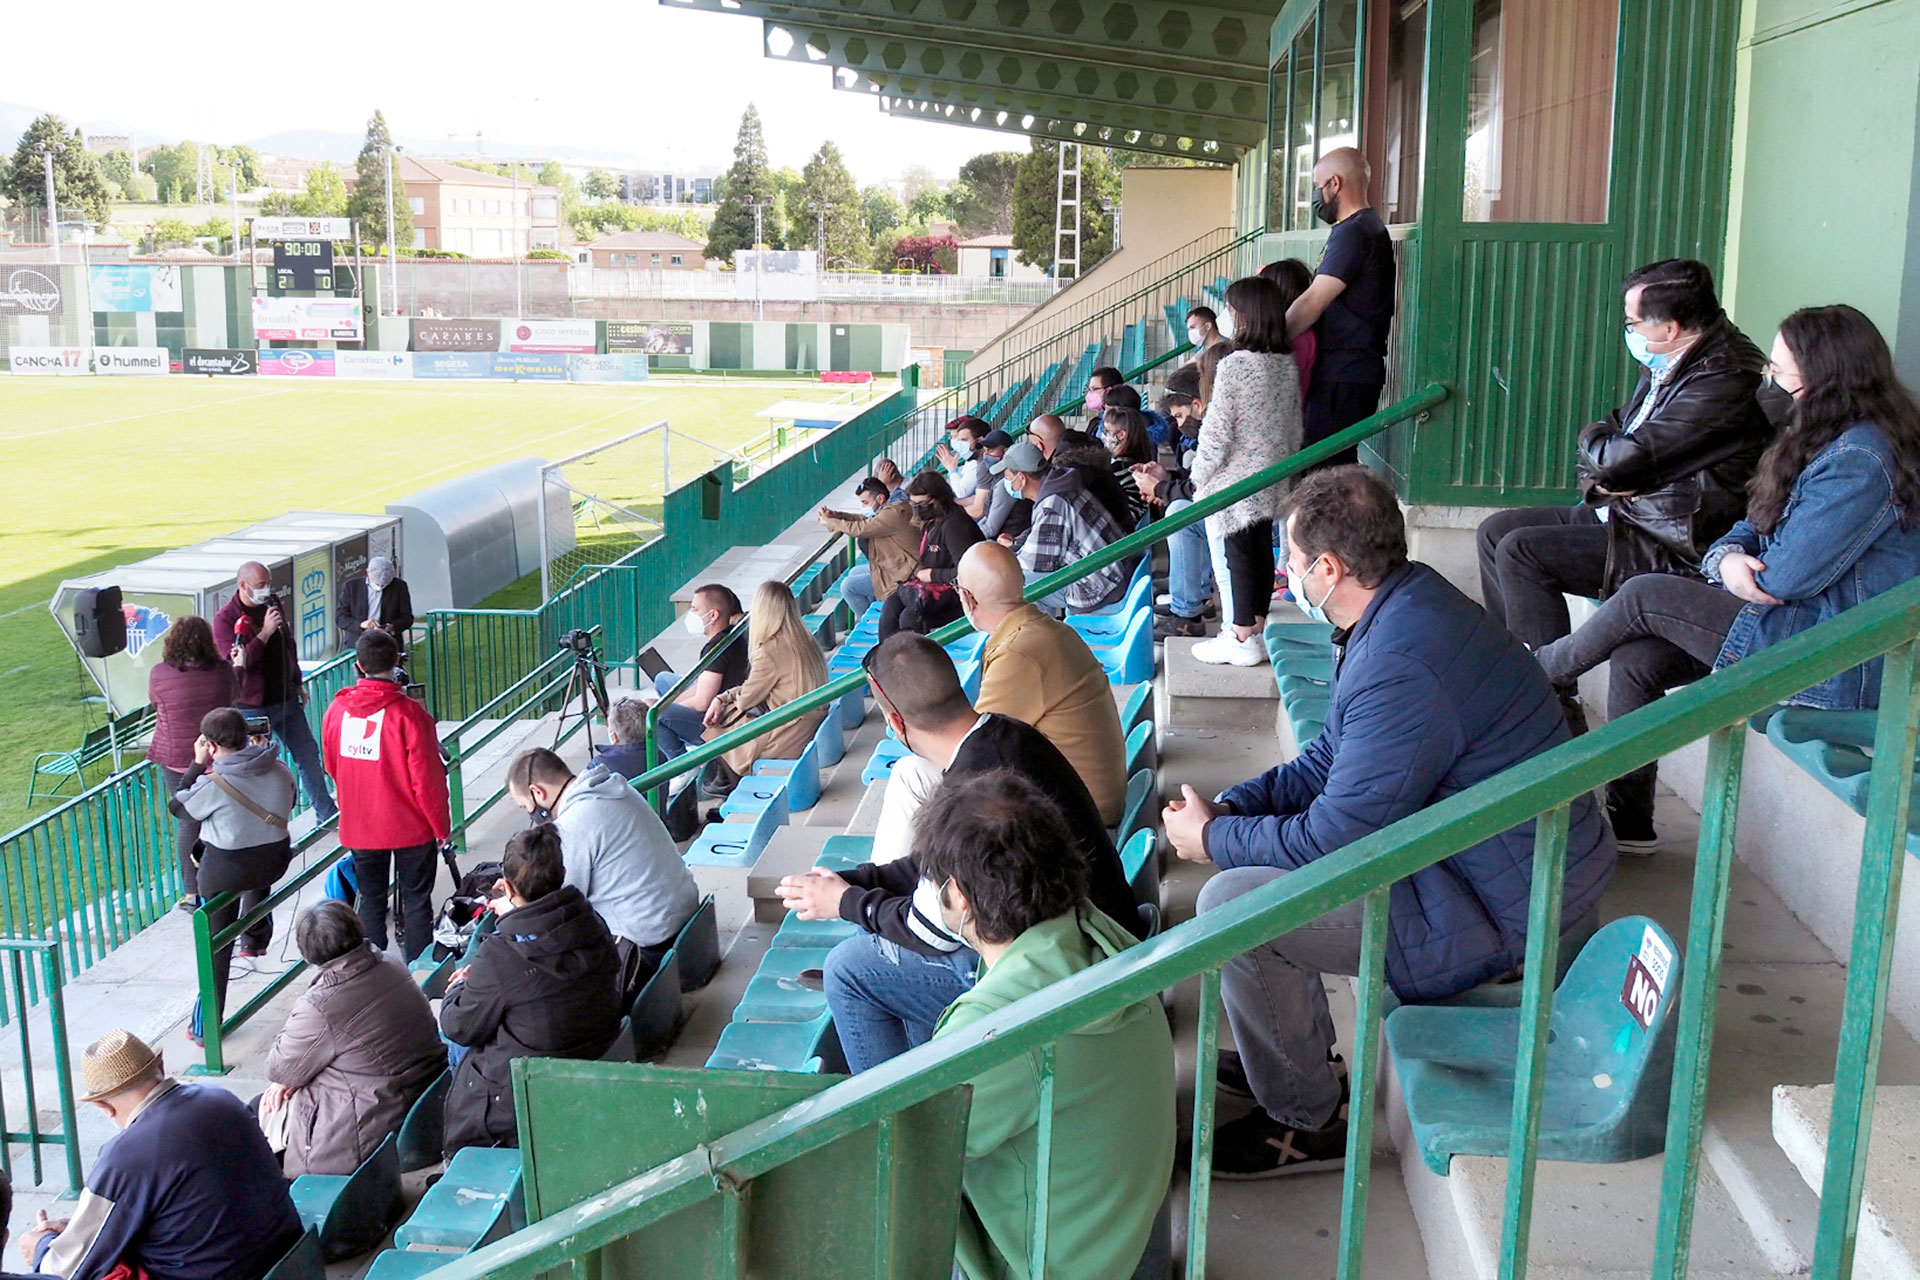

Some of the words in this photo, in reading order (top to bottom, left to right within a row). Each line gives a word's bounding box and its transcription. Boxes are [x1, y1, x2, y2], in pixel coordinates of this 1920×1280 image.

[284, 242, 321, 256] 90:00
[278, 276, 287, 289] 2
[322, 276, 331, 289] 0
[14, 355, 62, 367] CANCHA
[62, 349, 83, 367] 17
[113, 354, 161, 368] hummel
[343, 355, 385, 364] Carrefour
[347, 744, 373, 757] cyltv
[1629, 968, 1658, 1027] NO
